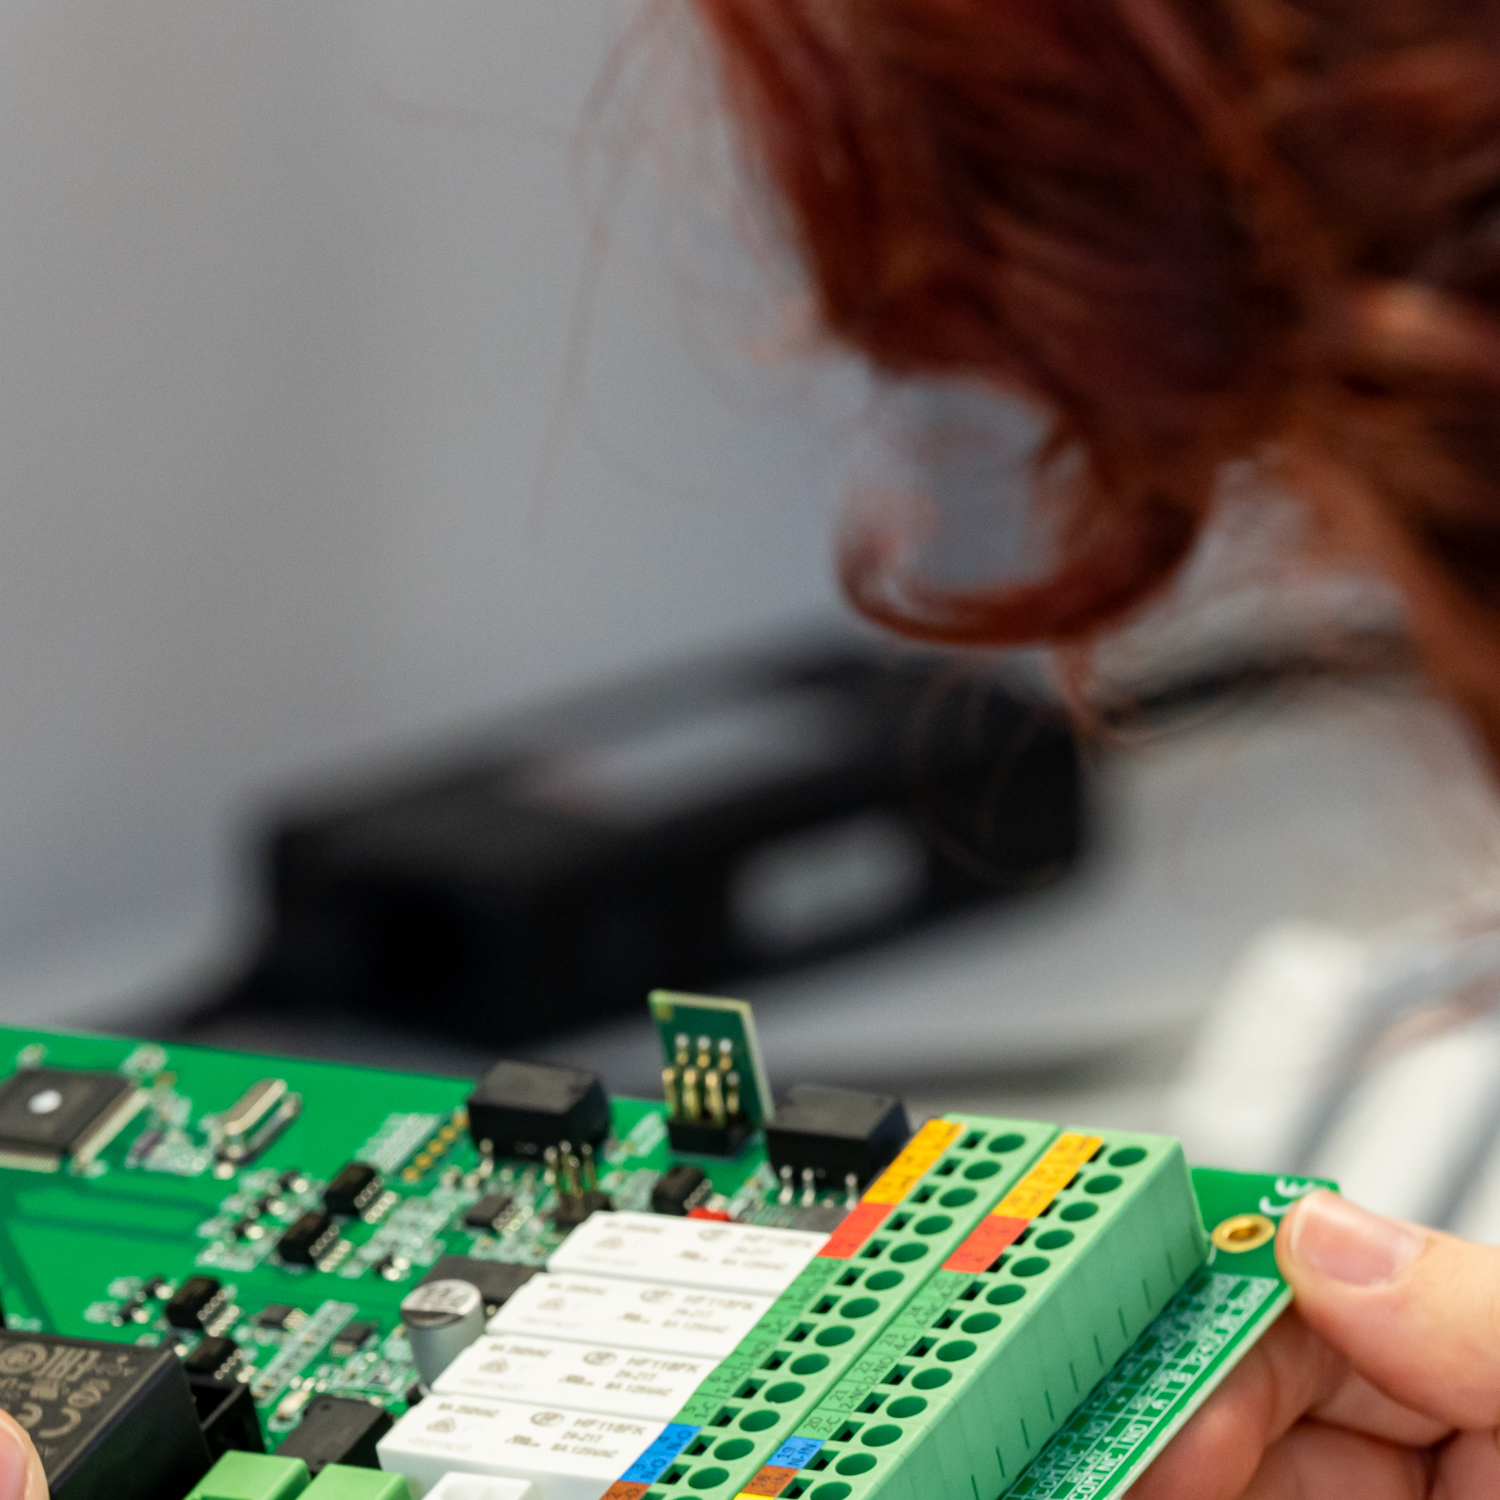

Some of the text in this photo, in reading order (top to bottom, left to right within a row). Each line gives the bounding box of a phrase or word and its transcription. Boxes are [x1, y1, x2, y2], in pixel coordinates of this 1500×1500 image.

[852, 1360, 875, 1373] 22
[826, 1389, 849, 1401] 21
[679, 1404, 698, 1413] 5
[800, 1416, 825, 1429] 20
[775, 1446, 797, 1458] 19
